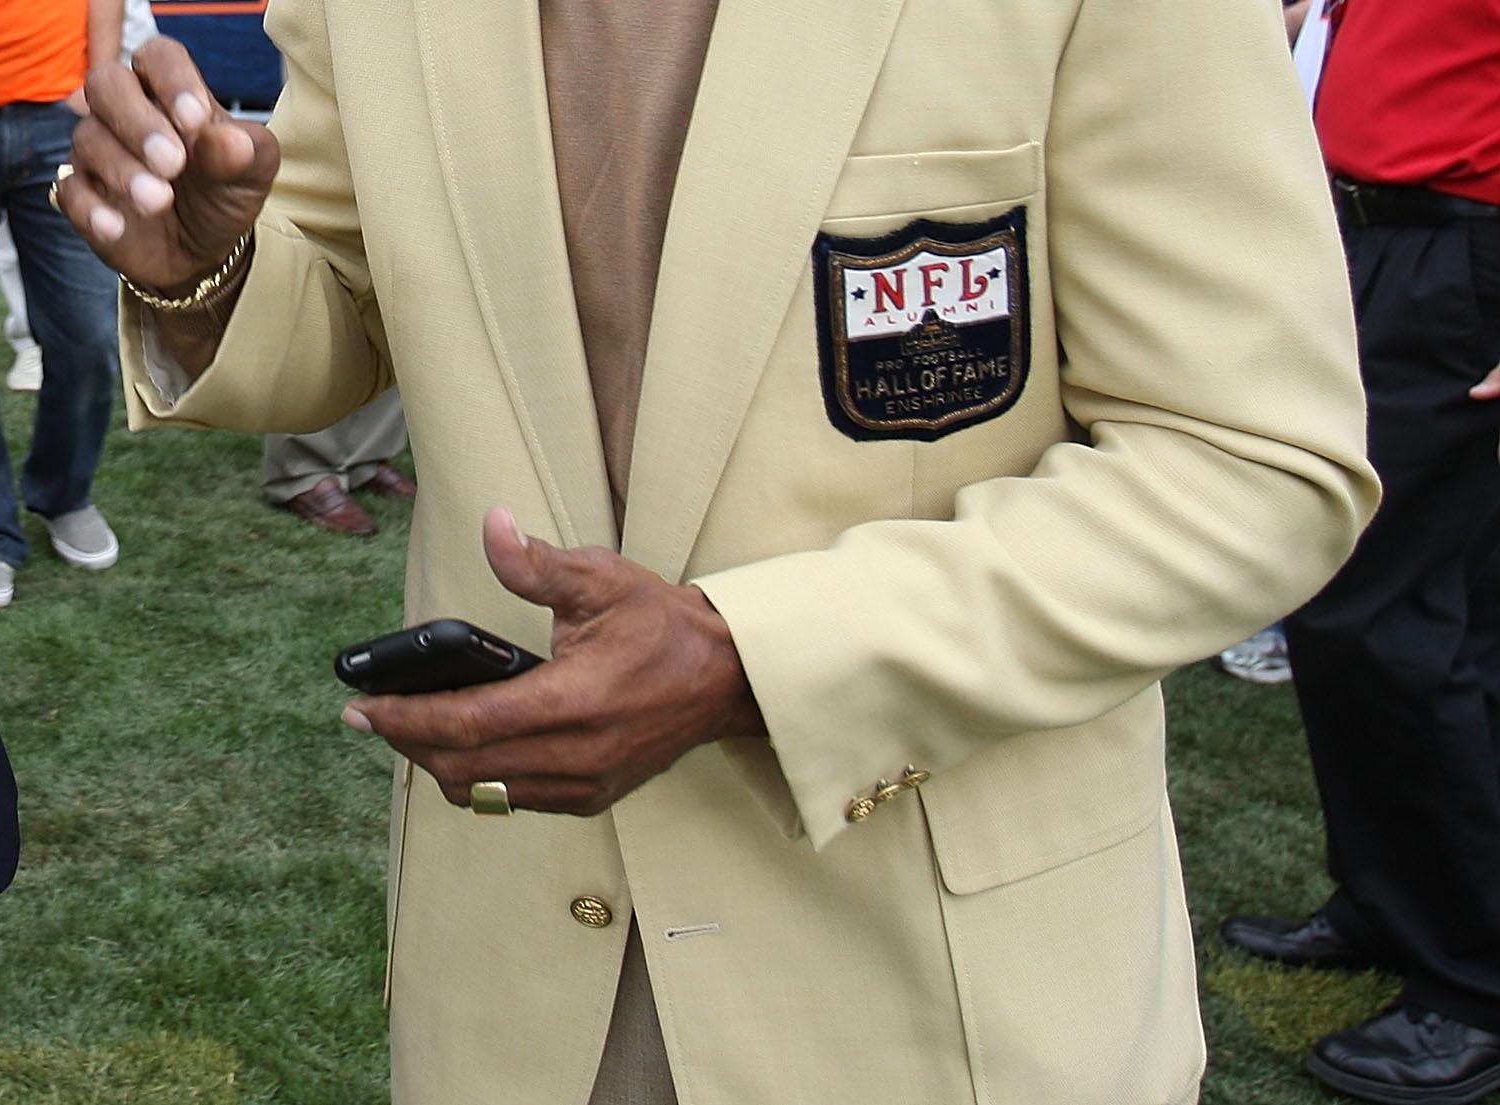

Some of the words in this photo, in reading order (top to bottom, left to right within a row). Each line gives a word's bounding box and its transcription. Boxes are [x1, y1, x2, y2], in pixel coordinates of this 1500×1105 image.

[871, 258, 989, 314] NFL
[864, 300, 995, 327] ALUMNI
[854, 372, 918, 399] HALL
[921, 366, 948, 391] OF
[952, 356, 1008, 385] FAME
